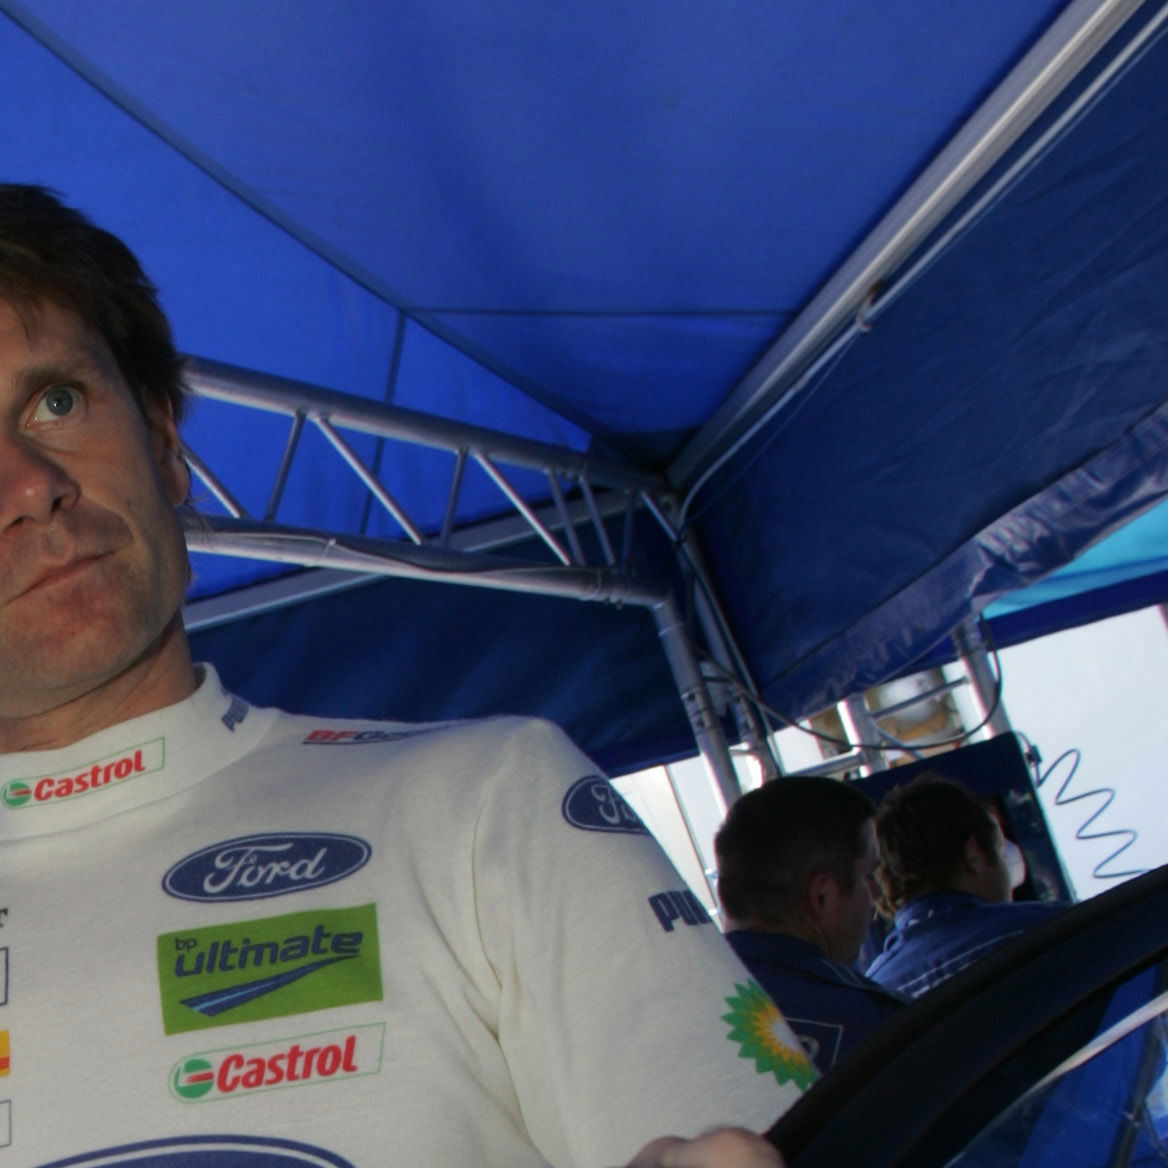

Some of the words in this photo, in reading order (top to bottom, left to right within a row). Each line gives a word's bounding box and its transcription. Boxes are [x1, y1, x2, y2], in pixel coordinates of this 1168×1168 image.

[34, 750, 145, 801] Castrol
[202, 841, 328, 894] Ford
[174, 924, 363, 978] ultimate
[175, 935, 198, 953] bp
[217, 1035, 358, 1093] Castrol
